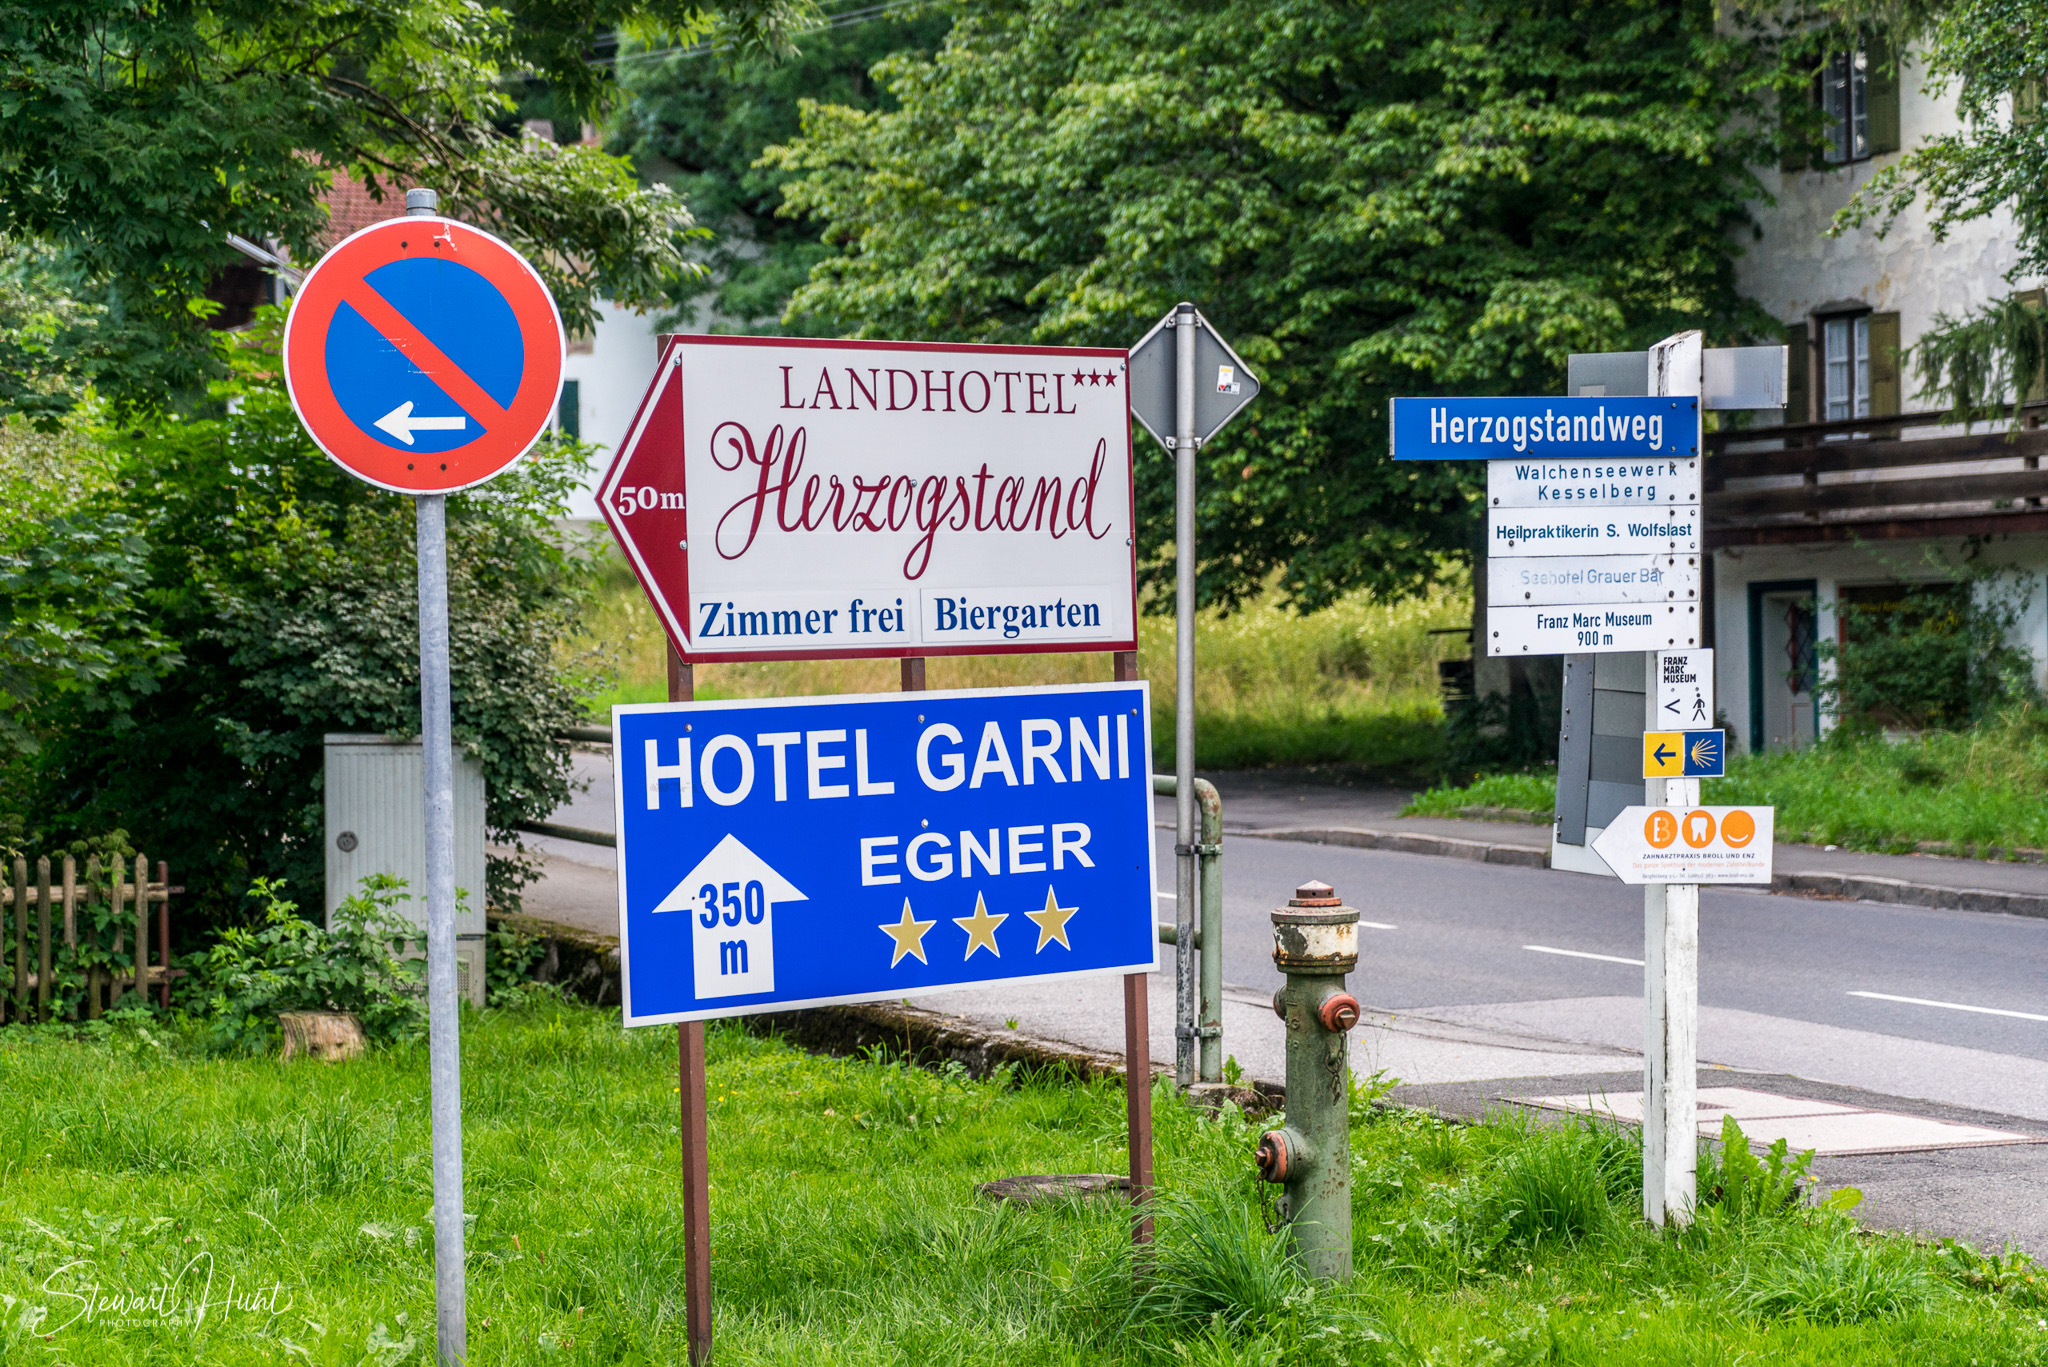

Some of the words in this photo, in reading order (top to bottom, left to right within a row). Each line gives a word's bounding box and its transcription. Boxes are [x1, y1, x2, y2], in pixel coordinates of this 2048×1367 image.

[779, 365, 1077, 415] LANDHOTEL
[1430, 406, 1664, 452] Herzogstandweg
[1515, 464, 1678, 480] Walchenseewerk
[617, 485, 686, 516] 50m
[709, 420, 1112, 580] Herzogstand
[1538, 484, 1656, 501] Kesselberg
[1496, 524, 1600, 543] Heilpraktikerin
[1606, 524, 1620, 538] S.
[1628, 523, 1692, 538] Wolfslast
[1520, 570, 1584, 586] Seehotel
[1587, 568, 1637, 584] Grauer
[1640, 567, 1665, 583] Bär
[699, 600, 838, 639] Zimmer
[850, 598, 905, 632] frei
[934, 596, 1101, 638] Biergarten
[1537, 614, 1568, 629] Franz
[1573, 613, 1600, 628] Marc
[1605, 611, 1652, 626] Museum
[1577, 631, 1599, 646] 900
[1603, 634, 1613, 646] m
[1663, 656, 1688, 665] FRANZ
[1663, 666, 1684, 674] MARC
[1663, 674, 1697, 683] MUSEUM
[645, 729, 895, 811] HOTEL
[916, 714, 1130, 792] GARNI
[860, 822, 1096, 887] EGNER
[698, 880, 765, 928] 350
[719, 939, 749, 976] m
